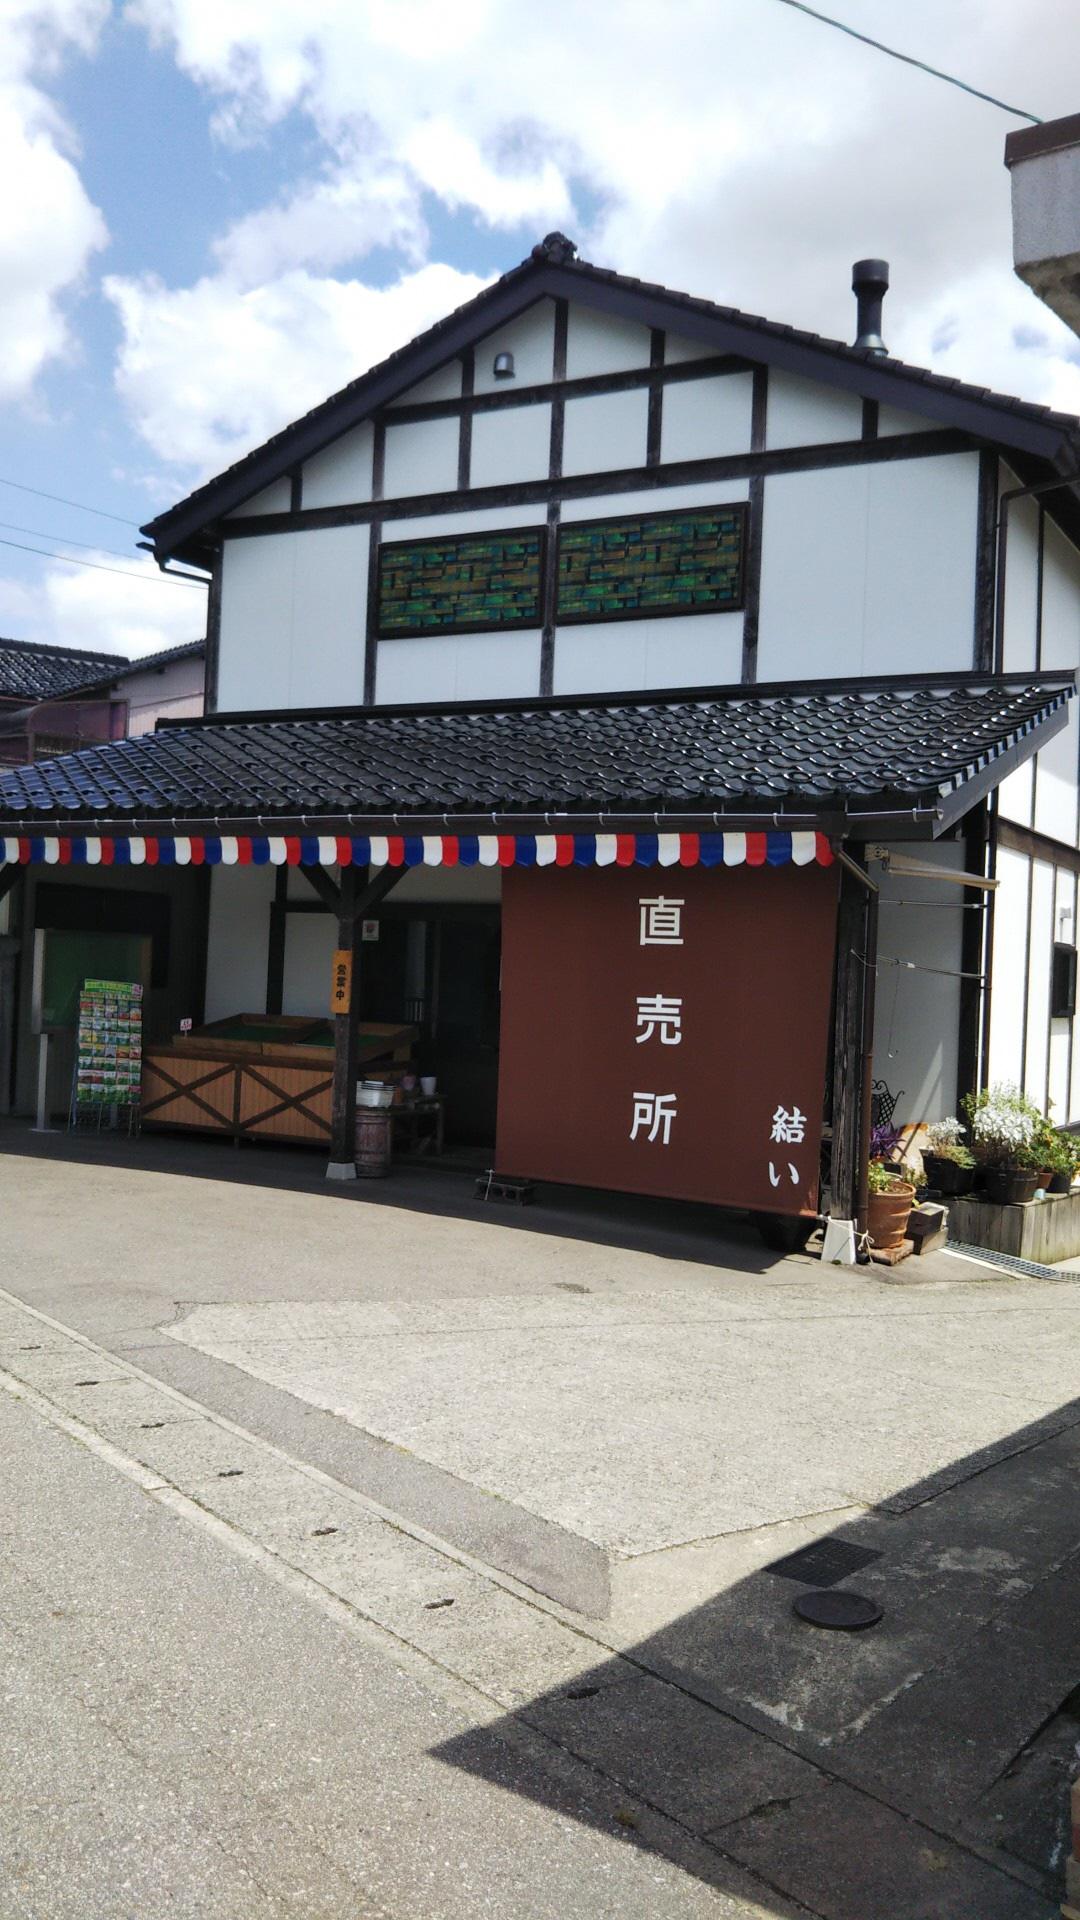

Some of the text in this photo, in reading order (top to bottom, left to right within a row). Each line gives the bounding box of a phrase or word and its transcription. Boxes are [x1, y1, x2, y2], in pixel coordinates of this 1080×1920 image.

[629, 895, 685, 1145] 直売所
[769, 1104, 807, 1187] 結い
